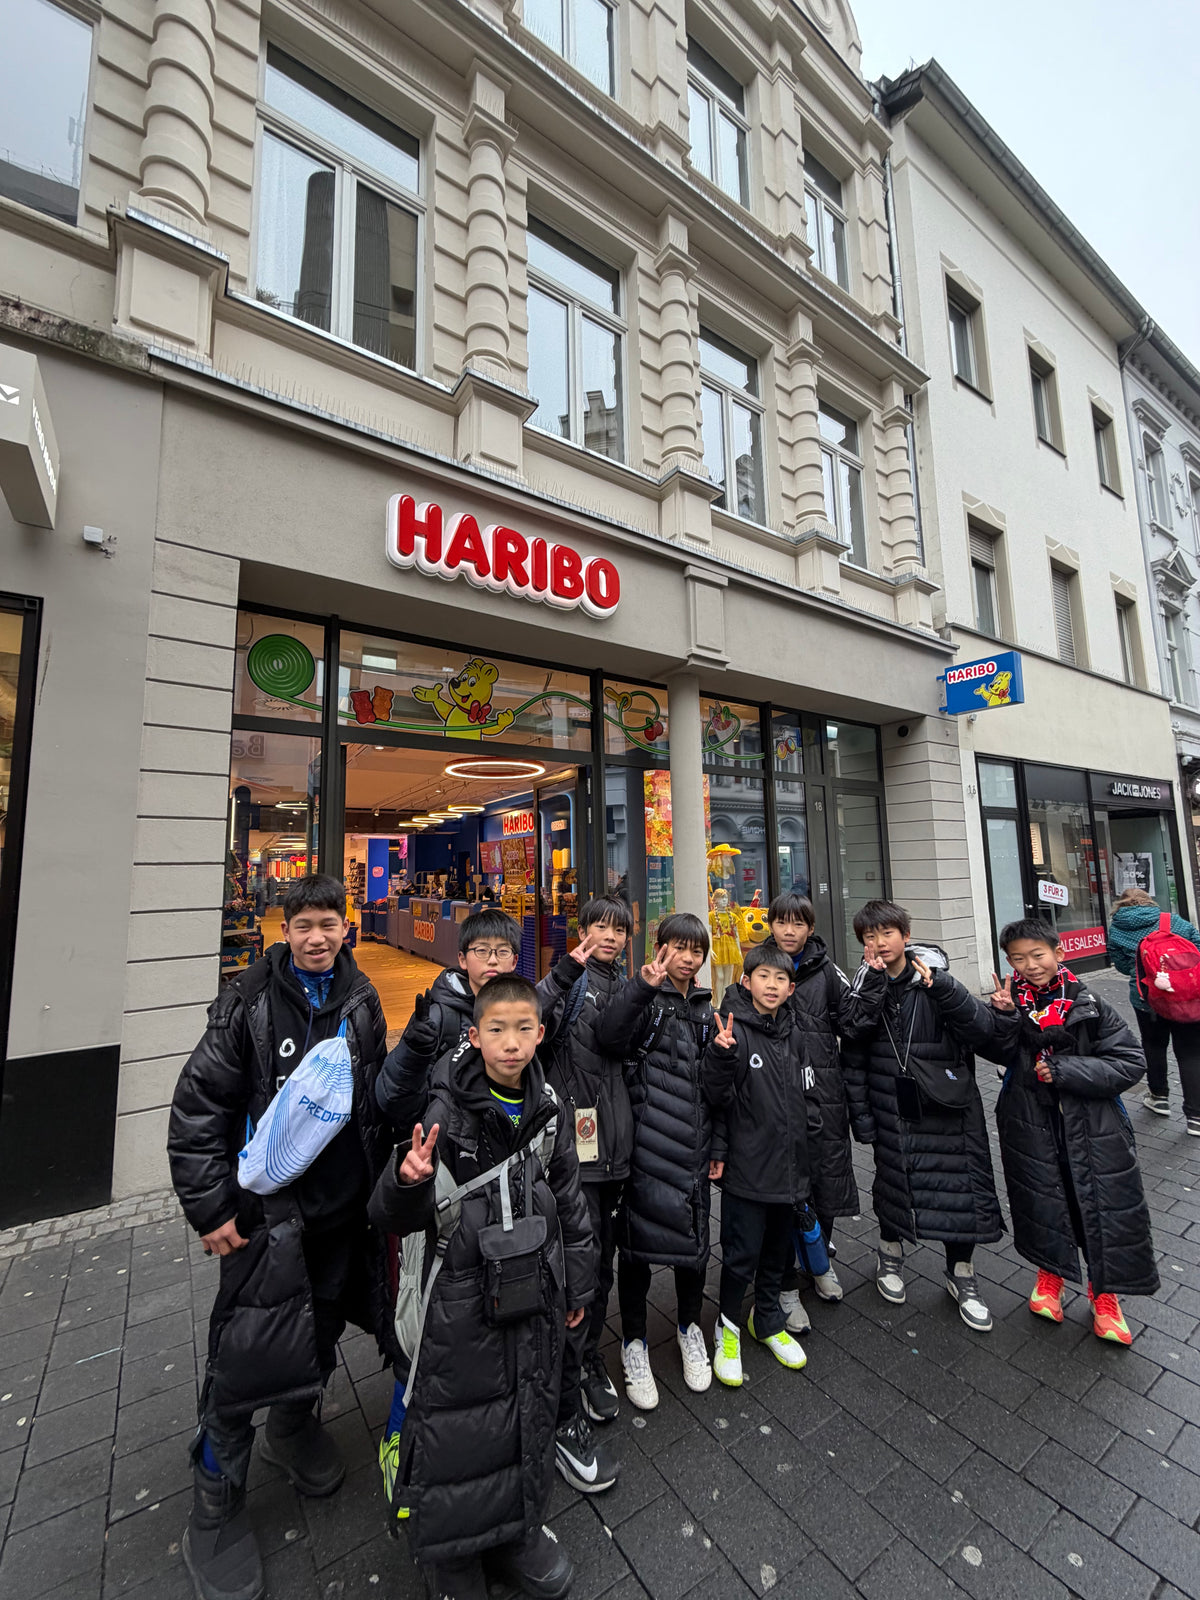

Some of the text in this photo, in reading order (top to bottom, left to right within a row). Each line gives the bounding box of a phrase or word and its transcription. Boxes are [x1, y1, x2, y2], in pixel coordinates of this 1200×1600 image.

[396, 494, 621, 610] HARIBO
[947, 662, 996, 683] HARIBO
[1112, 781, 1132, 797] JACK
[1139, 785, 1161, 799] JONES
[503, 812, 534, 835] HARIBO
[1043, 884, 1048, 894] 3
[1060, 888, 1064, 898] 2
